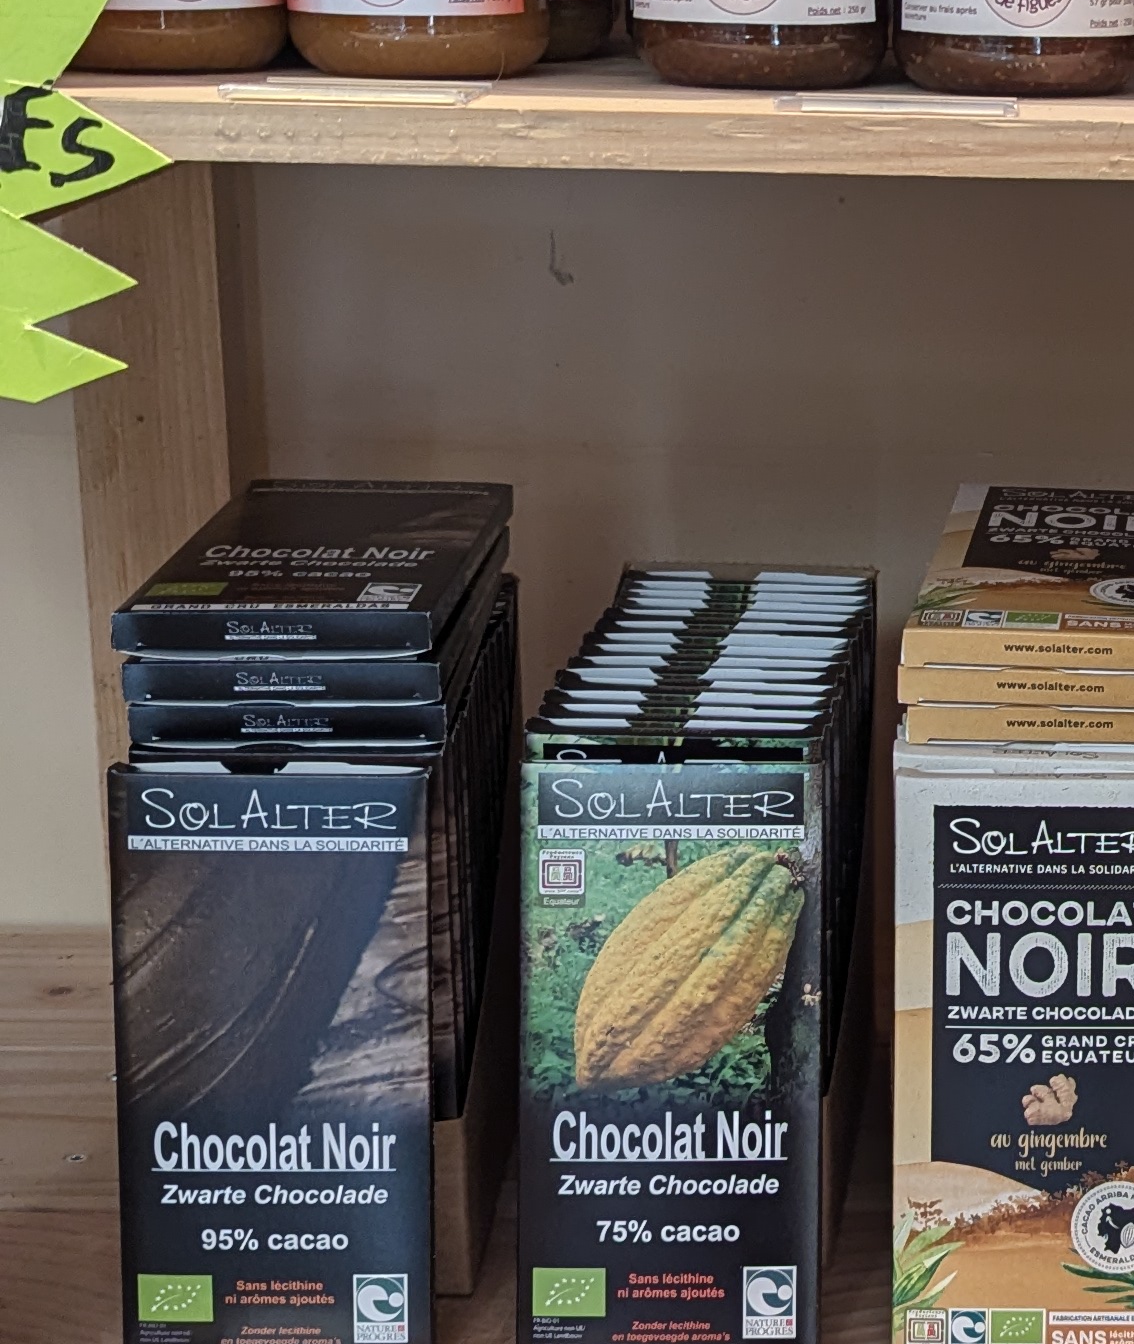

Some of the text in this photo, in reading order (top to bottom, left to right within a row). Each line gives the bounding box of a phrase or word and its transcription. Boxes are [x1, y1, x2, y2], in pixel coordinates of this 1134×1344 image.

[1004, 644, 1113, 655] www.solalter.com
[131, 837, 405, 852] L'ALTERNATIVE DANS LA SOLIDARITÉ
[950, 863, 1033, 874] L'ALTERNATIVE
[1037, 863, 1067, 874] DANS
[1071, 863, 1086, 874] LA
[947, 1006, 1027, 1020] ZWARTE
[953, 1034, 1036, 1063] 65%
[1042, 1036, 1107, 1048] GRAND
[552, 1110, 788, 1160] Chocolat Noir
[1019, 1127, 1108, 1158] gingembre
[154, 1121, 397, 1171] Chocolat Noir
[161, 1185, 389, 1205] Zwarte Chocolade
[558, 1174, 779, 1196] Zwarte Chocolade
[1081, 1201, 1096, 1236] CACAO
[1096, 1191, 1129, 1205] ARRIBA
[201, 1228, 348, 1252] 95% cacao
[596, 1220, 740, 1243] 75% cacao
[236, 1280, 323, 1292] Sans lécithine
[225, 1294, 335, 1307] ni arômes ajoutés
